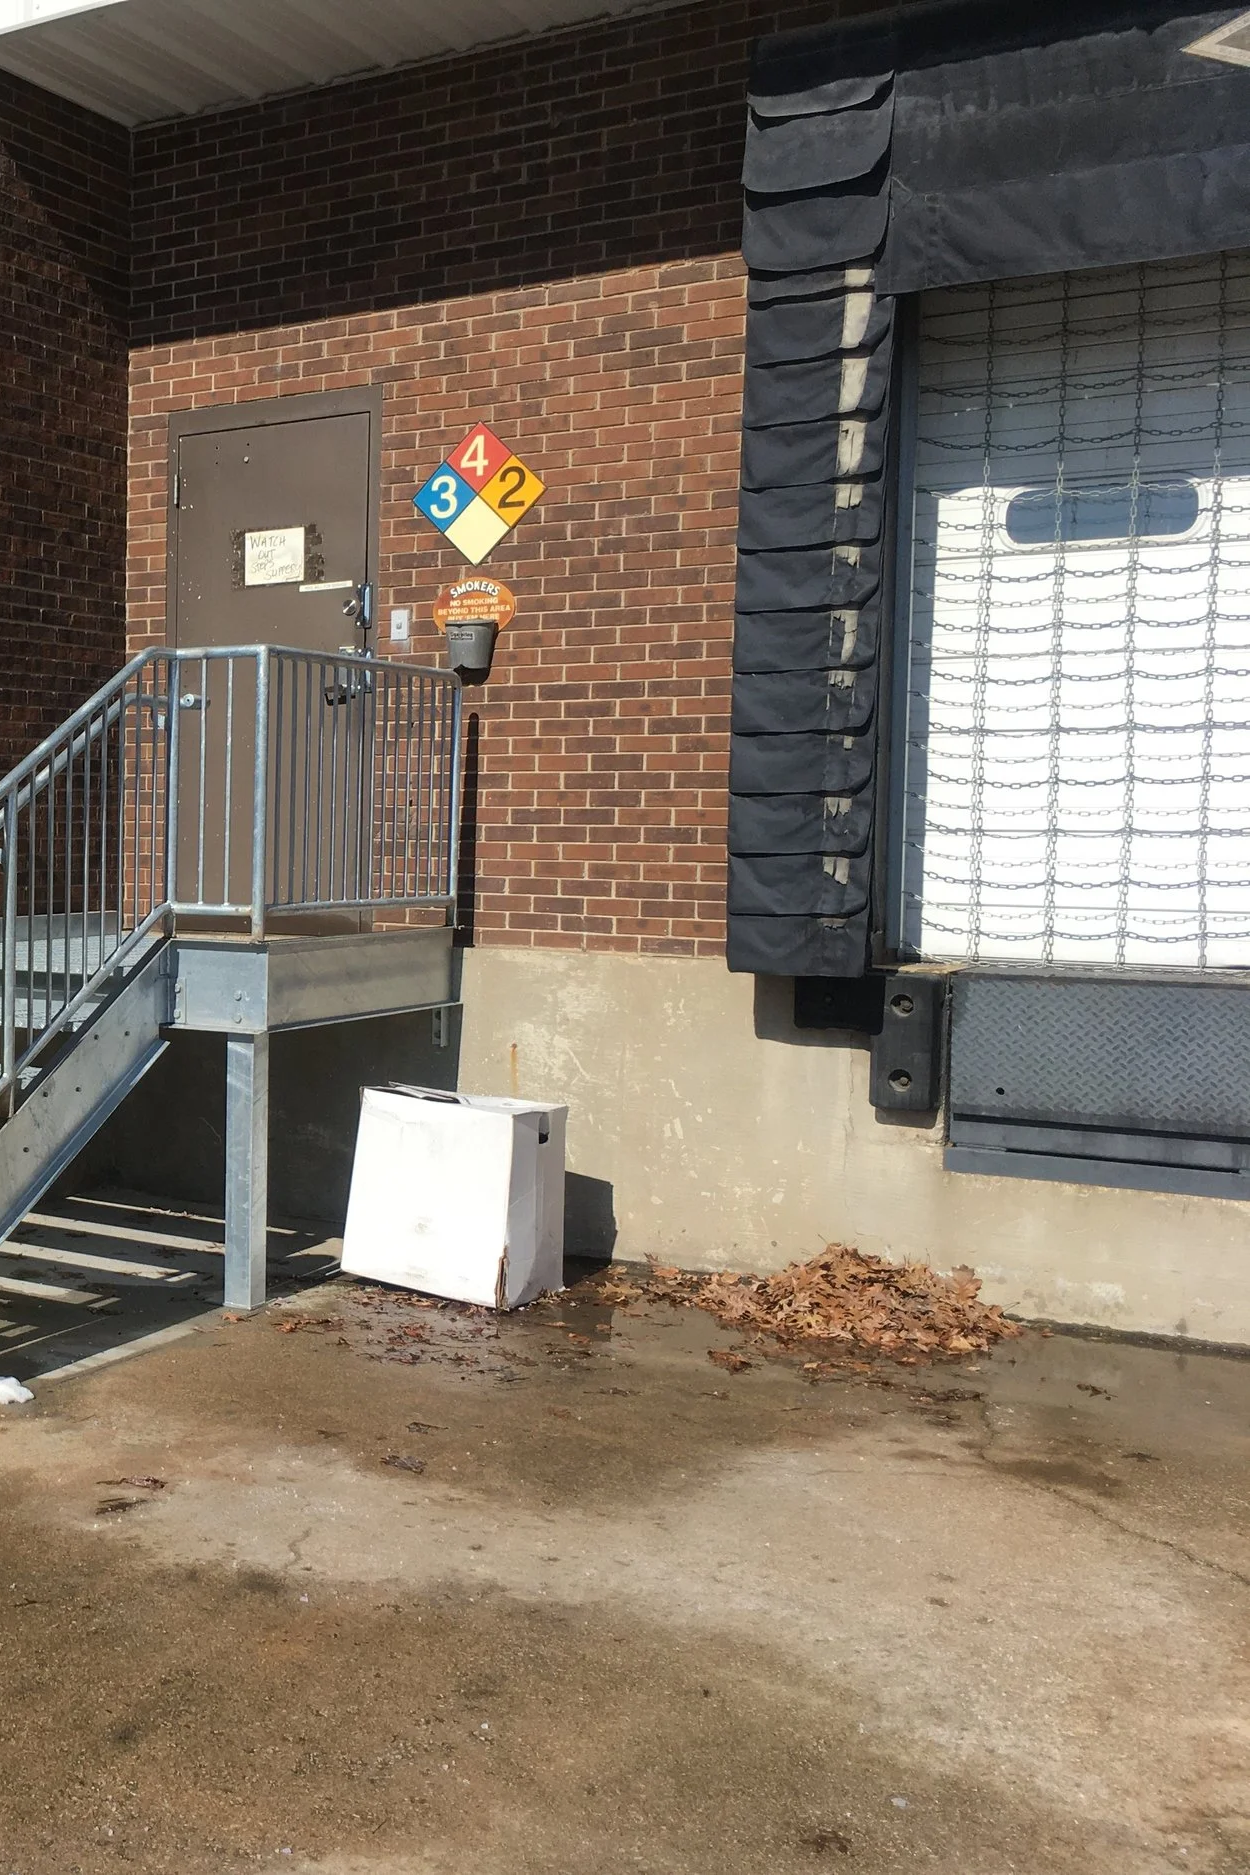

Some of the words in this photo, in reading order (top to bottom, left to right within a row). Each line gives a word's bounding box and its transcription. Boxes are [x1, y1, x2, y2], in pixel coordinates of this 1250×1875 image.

[460, 435, 488, 476] 4
[498, 466, 526, 509] 2
[430, 475, 457, 519] 3
[250, 535, 286, 550] WATCH
[256, 549, 276, 560] OUT
[450, 580, 501, 598] SMOKERS
[437, 608, 469, 616] BEYOND
[470, 606, 488, 614] THIS
[490, 604, 511, 612] AREA
[462, 598, 499, 606] SMOKING
